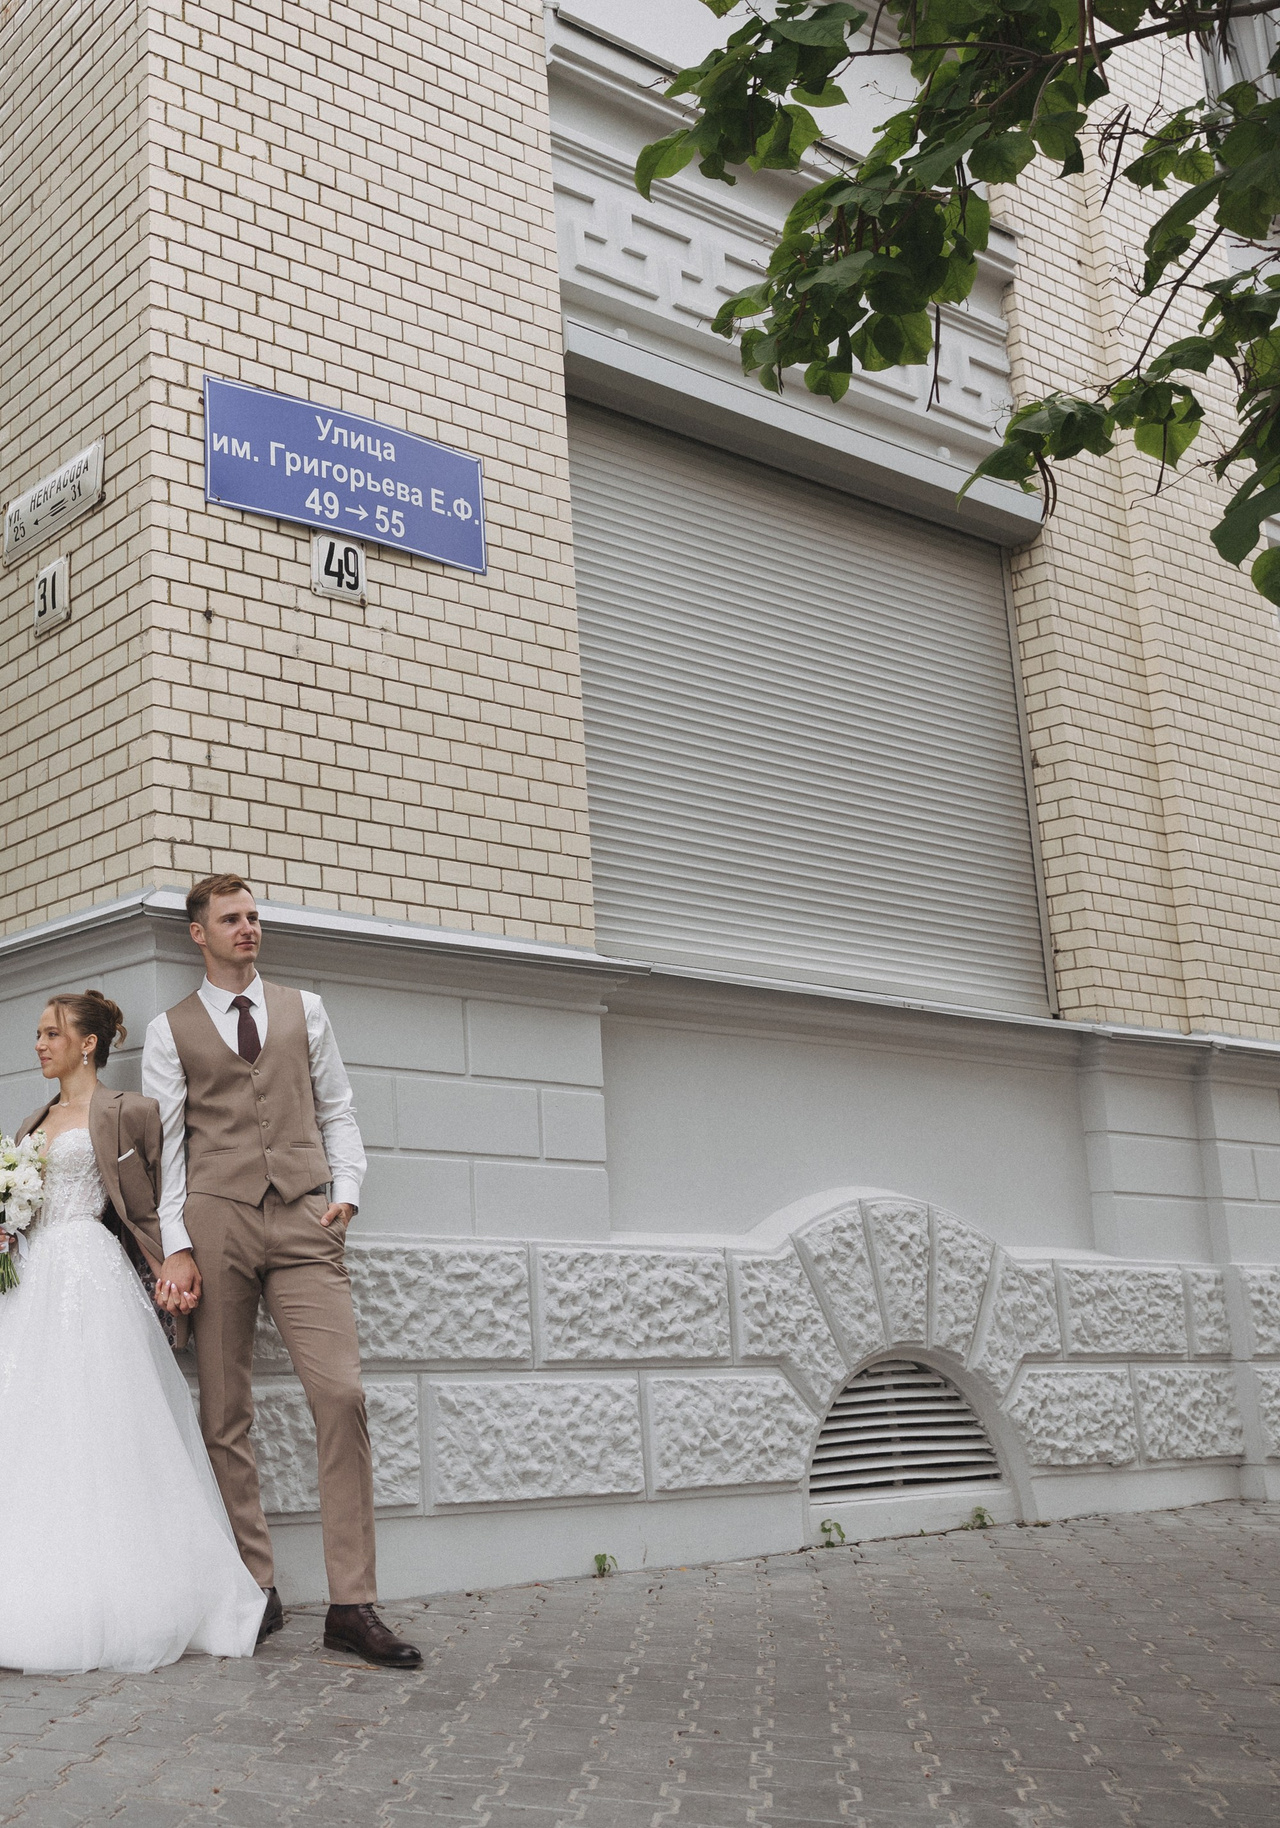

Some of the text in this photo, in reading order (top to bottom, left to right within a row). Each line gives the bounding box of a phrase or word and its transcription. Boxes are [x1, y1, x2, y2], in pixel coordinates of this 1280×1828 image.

[314, 415, 396, 462] Улица
[29, 455, 89, 512] НЕКРАСОВА
[212, 432, 480, 526] им. Григорьева Е.Ф.
[13, 480, 82, 542] 25 31
[305, 488, 406, 538] 49 55
[323, 541, 359, 591] 49
[37, 570, 57, 618] 31
